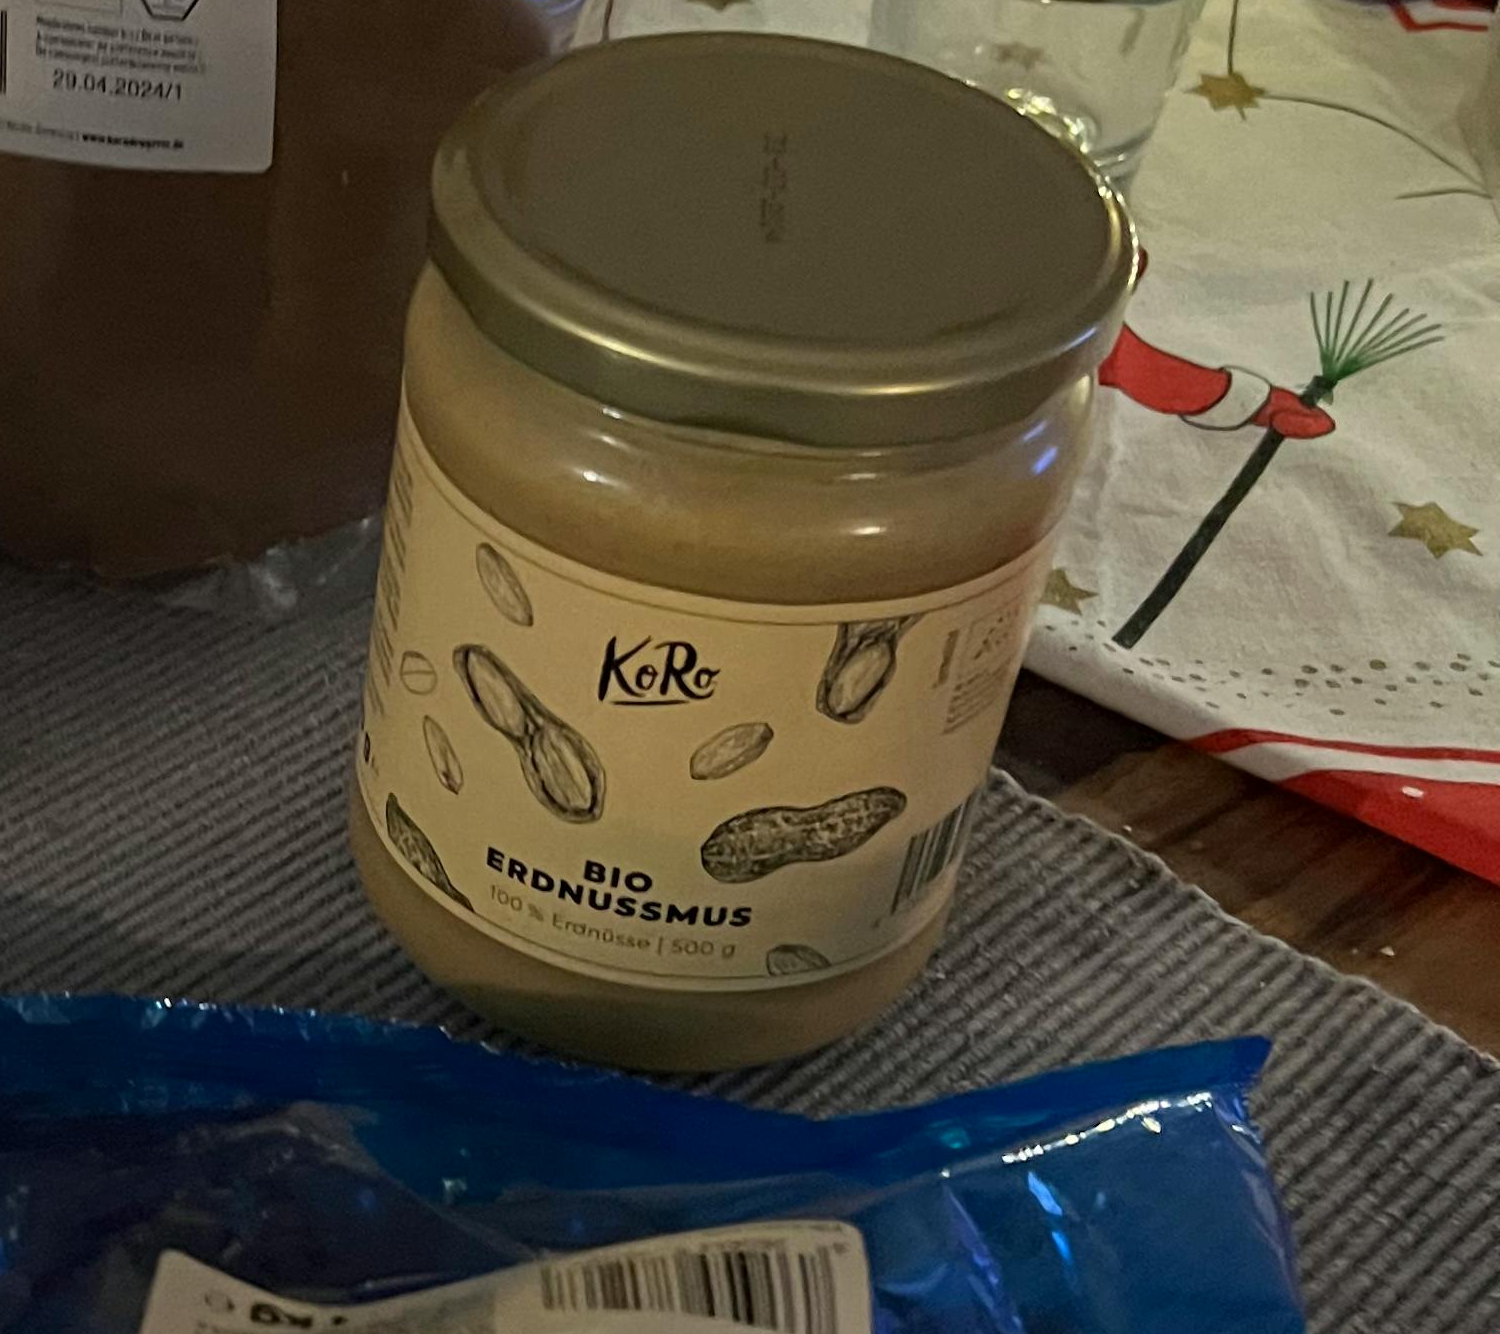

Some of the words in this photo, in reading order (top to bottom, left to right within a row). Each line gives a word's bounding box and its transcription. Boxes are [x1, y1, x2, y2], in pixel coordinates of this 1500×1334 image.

[52, 68, 182, 101] 29.04.2024/1
[598, 635, 721, 706] KoRo
[485, 846, 753, 928] ERDNUSSMUS
[583, 859, 653, 892] BIO
[489, 884, 523, 913] 100
[551, 912, 651, 950] Erdnüsse
[671, 937, 714, 956] 500
[721, 943, 737, 960] g
